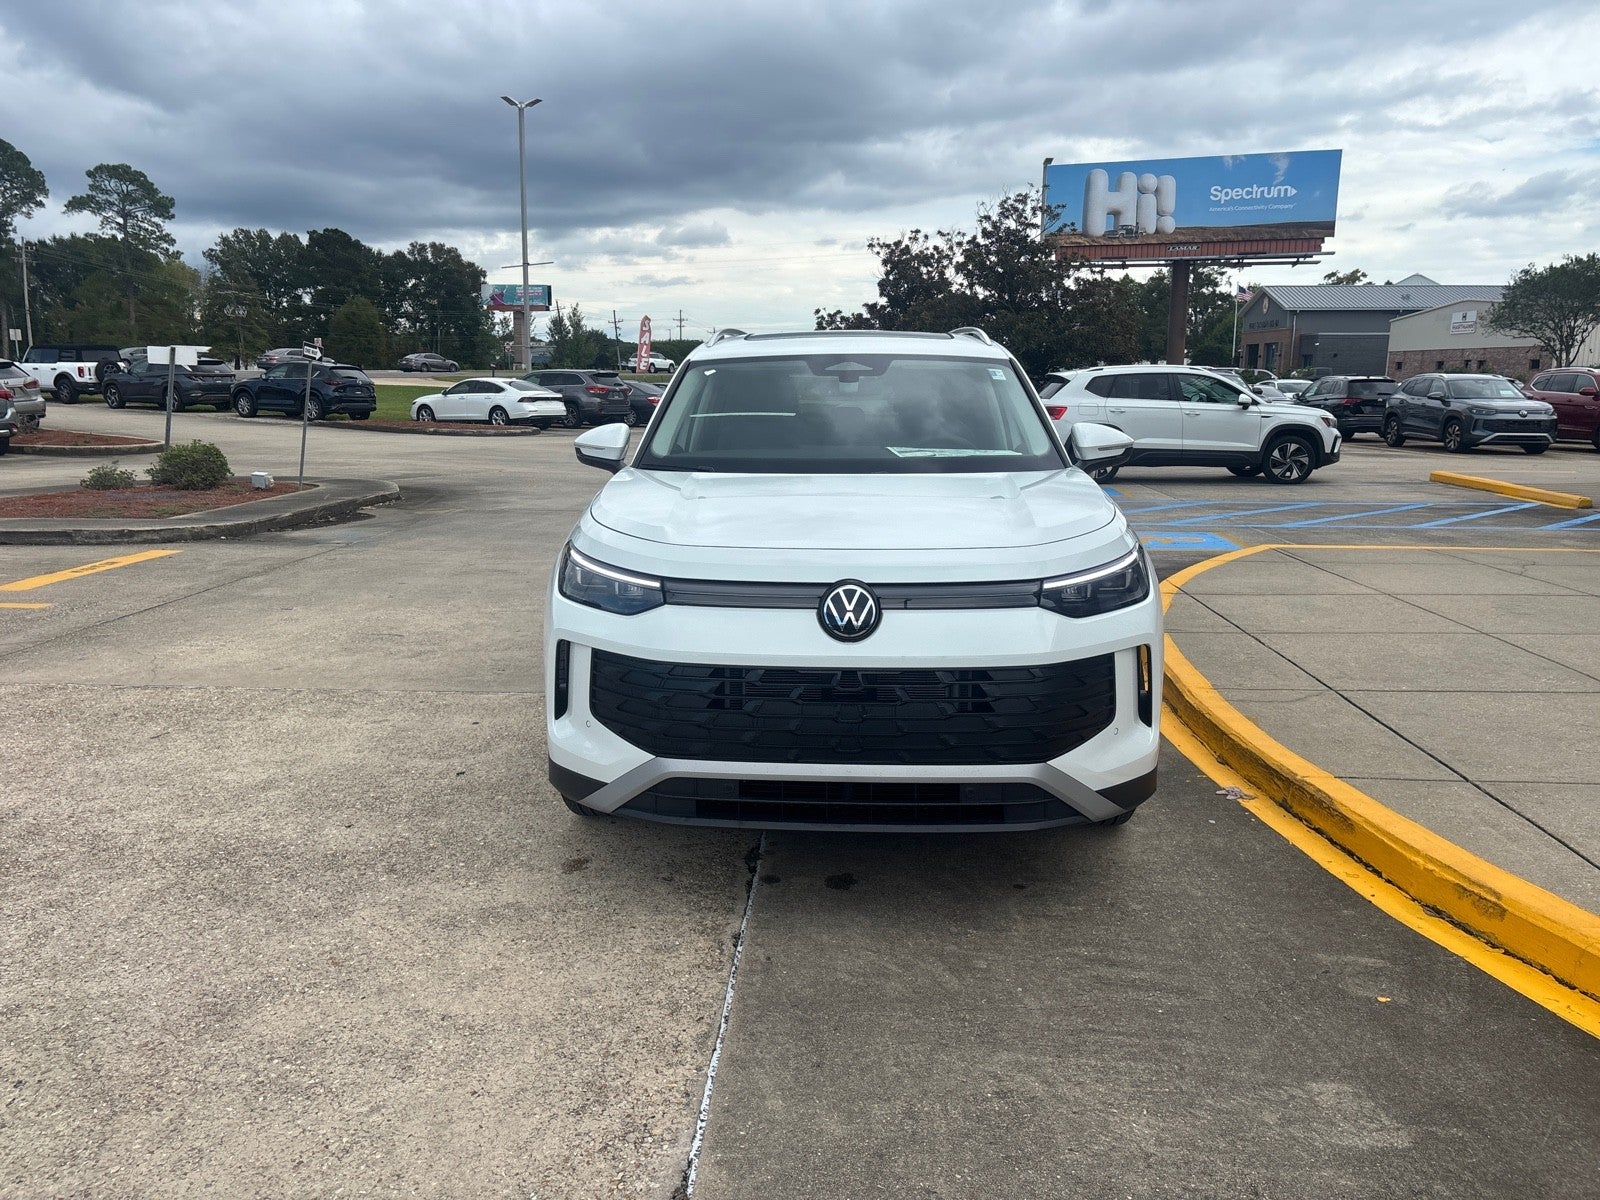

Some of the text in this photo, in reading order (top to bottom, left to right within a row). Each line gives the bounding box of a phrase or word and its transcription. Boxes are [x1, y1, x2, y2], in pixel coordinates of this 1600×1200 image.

[1082, 168, 1176, 237] Hi!
[1210, 184, 1291, 204] Spectrum
[640, 319, 650, 370] SALE
